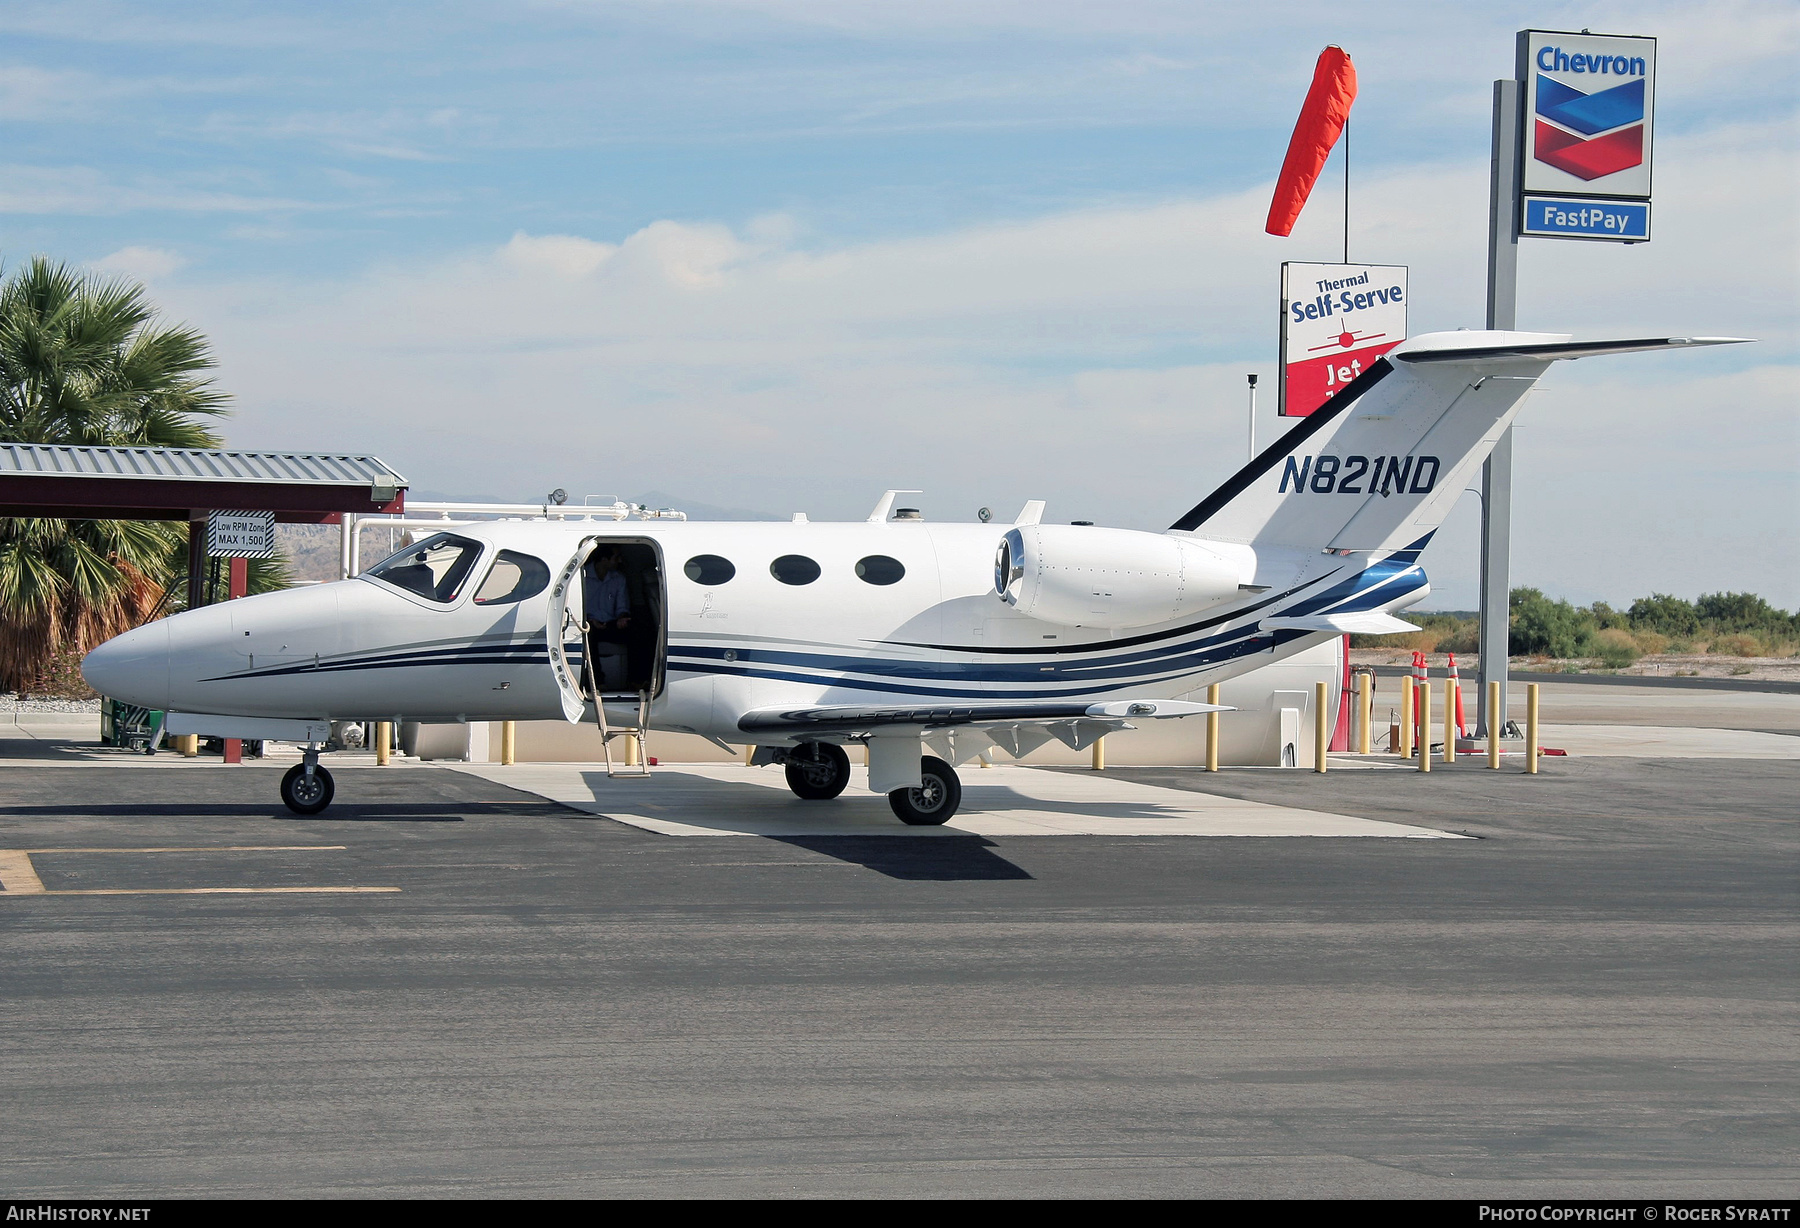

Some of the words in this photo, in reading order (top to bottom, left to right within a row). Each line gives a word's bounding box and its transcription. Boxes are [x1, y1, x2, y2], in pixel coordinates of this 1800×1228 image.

[1537, 46, 1646, 76] Chevron
[1544, 206, 1629, 233] FastPay
[1316, 271, 1369, 293] Thermal
[1291, 284, 1403, 323] Self-Serve
[1326, 359, 1361, 386] Jet
[1278, 455, 1440, 494] N821ND
[218, 522, 231, 530] Low
[233, 522, 247, 531] RPM
[249, 523, 264, 532] Zone
[218, 535, 238, 544] MAX
[242, 536, 263, 546] 1,500
